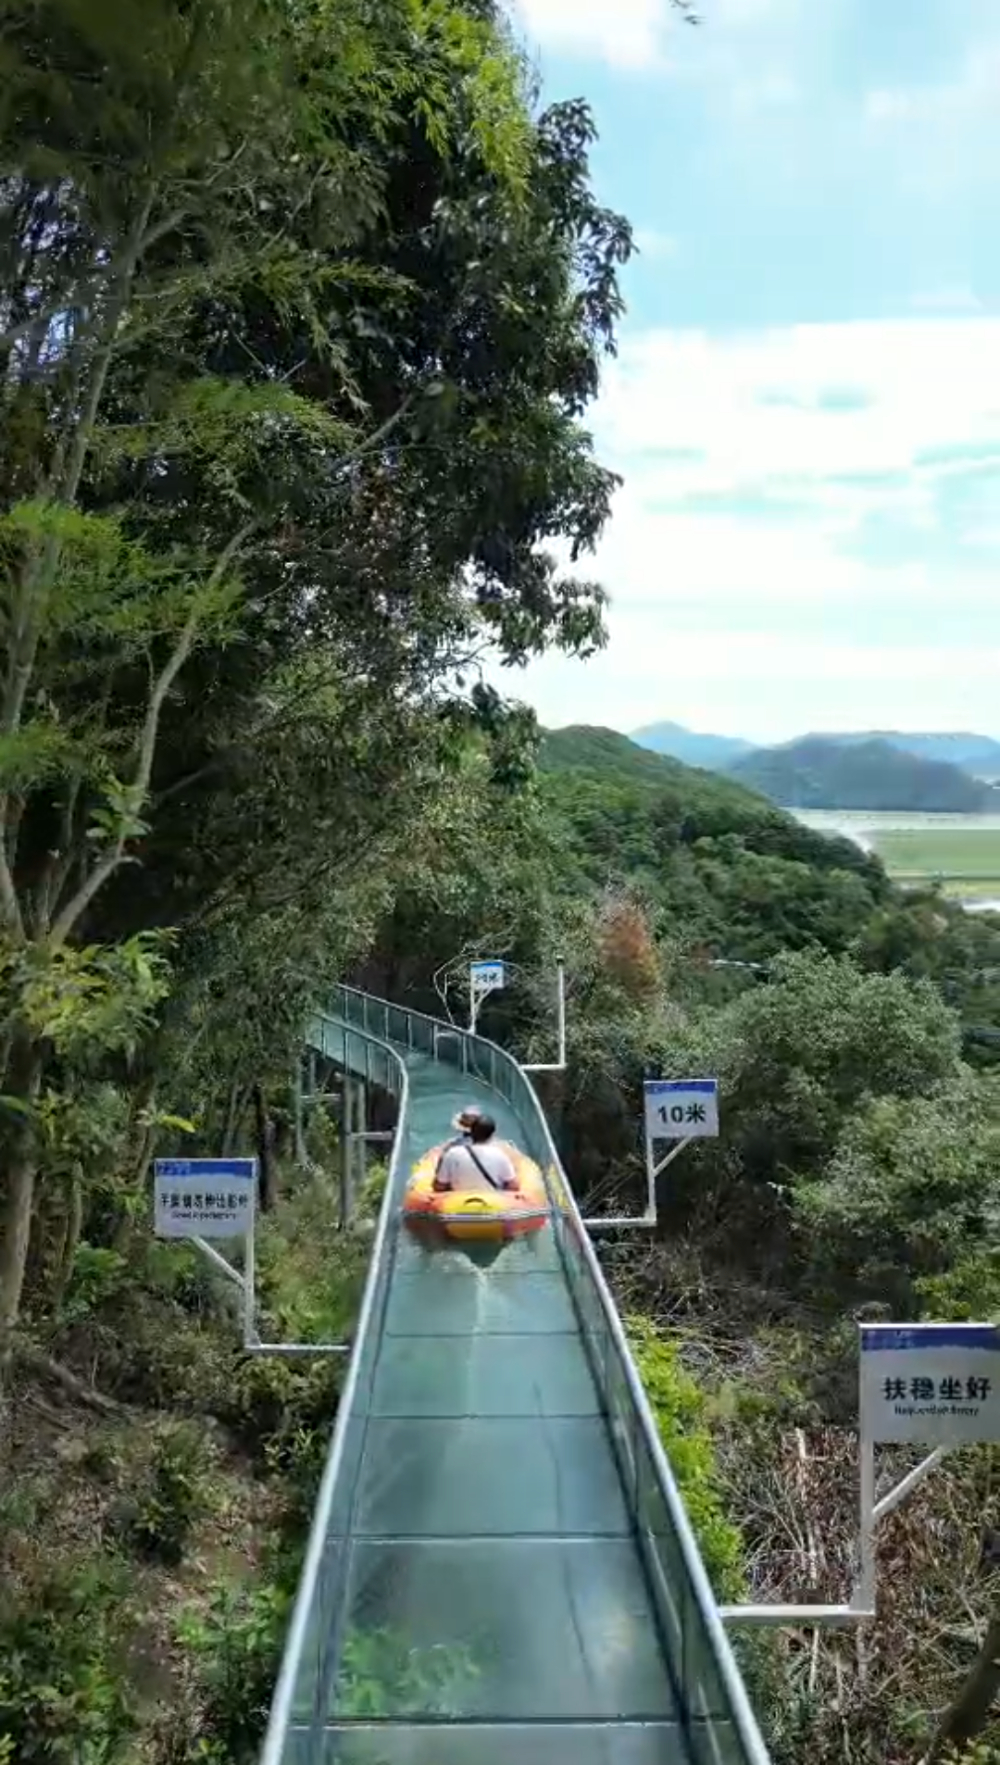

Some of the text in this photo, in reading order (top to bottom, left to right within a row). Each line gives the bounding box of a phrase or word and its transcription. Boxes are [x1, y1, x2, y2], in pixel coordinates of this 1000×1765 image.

[658, 1103, 706, 1124] 10米
[882, 1376, 992, 1401] 扶稳坐好
